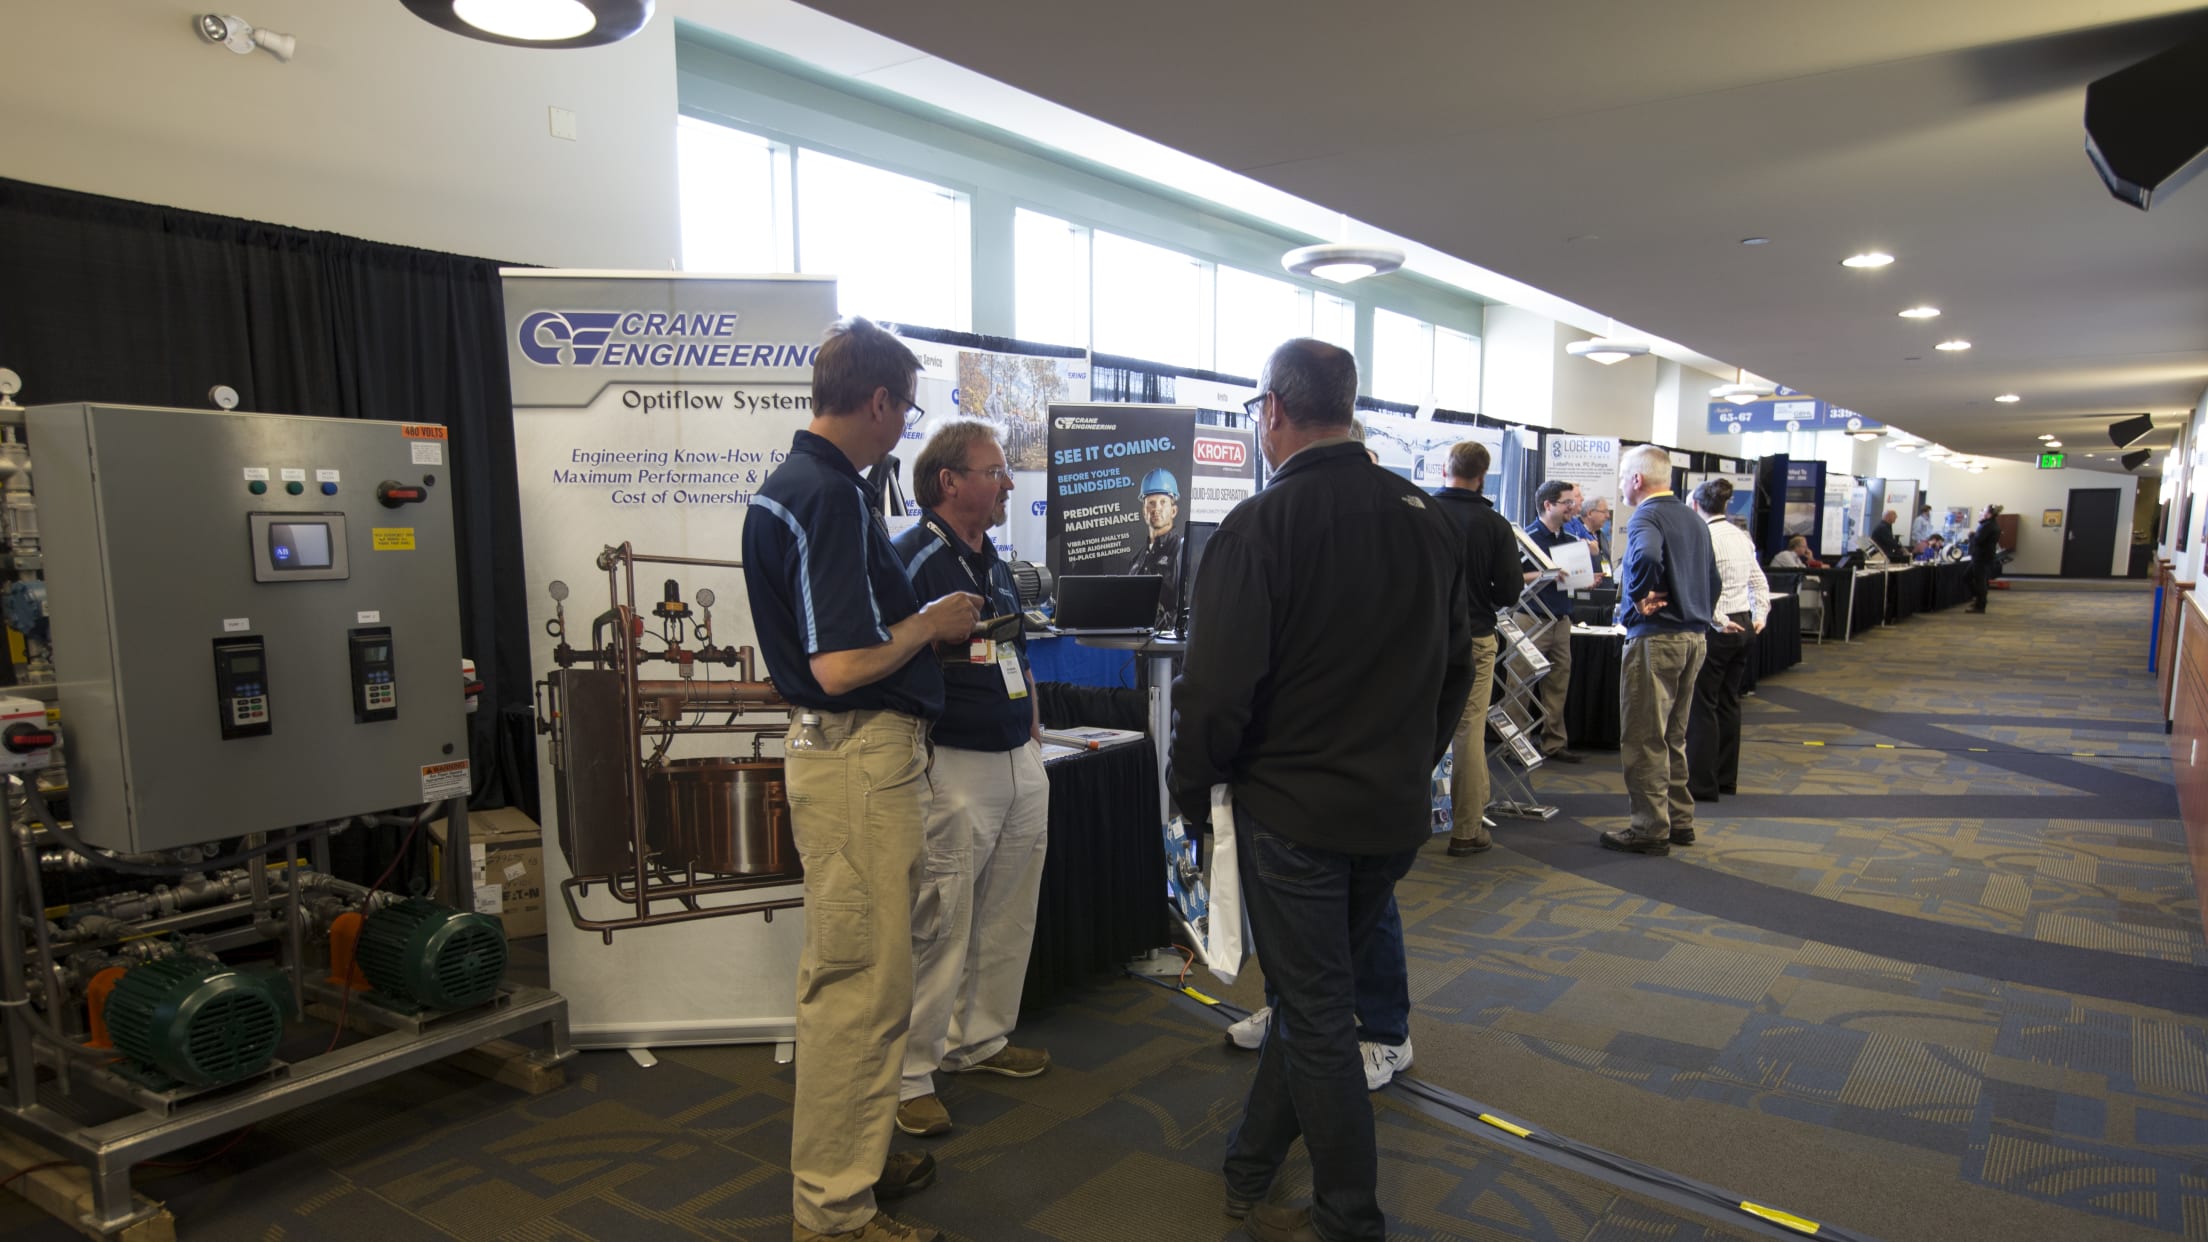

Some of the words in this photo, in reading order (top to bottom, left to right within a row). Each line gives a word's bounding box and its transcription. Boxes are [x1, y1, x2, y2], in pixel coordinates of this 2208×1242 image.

[621, 313, 737, 337] CRANE
[622, 390, 723, 414] Optiflow
[1720, 412, 1752, 422] 65-67
[405, 425, 420, 437] 480
[421, 426, 444, 438] VOLTS
[1054, 448, 1083, 465] SEE
[1085, 446, 1100, 461] IT
[1103, 437, 1176, 459] COMING.
[1197, 443, 1242, 461] KROFTA
[1564, 439, 1611, 453] LOBEPRO
[572, 448, 668, 466] Engineering
[674, 448, 763, 463] Know-How
[2042, 453, 2064, 468] EXIT
[553, 469, 632, 483] Maximum
[638, 469, 739, 483] Performance
[745, 469, 757, 483] &
[1057, 472, 1089, 484] BEFORE
[1090, 467, 1120, 478] YOU'RE
[1058, 476, 1135, 496] BLINDSIDED.
[611, 490, 646, 503] Cost
[652, 490, 669, 503] of
[1063, 502, 1121, 520] PREDICTIVE
[1065, 512, 1140, 533] MAINTENANCE
[1067, 537, 1100, 548] VIBRATION
[1100, 533, 1130, 543] ANALYSIS
[1067, 547, 1086, 556] LASER
[1087, 541, 1122, 553] ALIGNMENT
[1068, 553, 1096, 562] IN-PLACE
[1096, 547, 1131, 558] BALANCING
